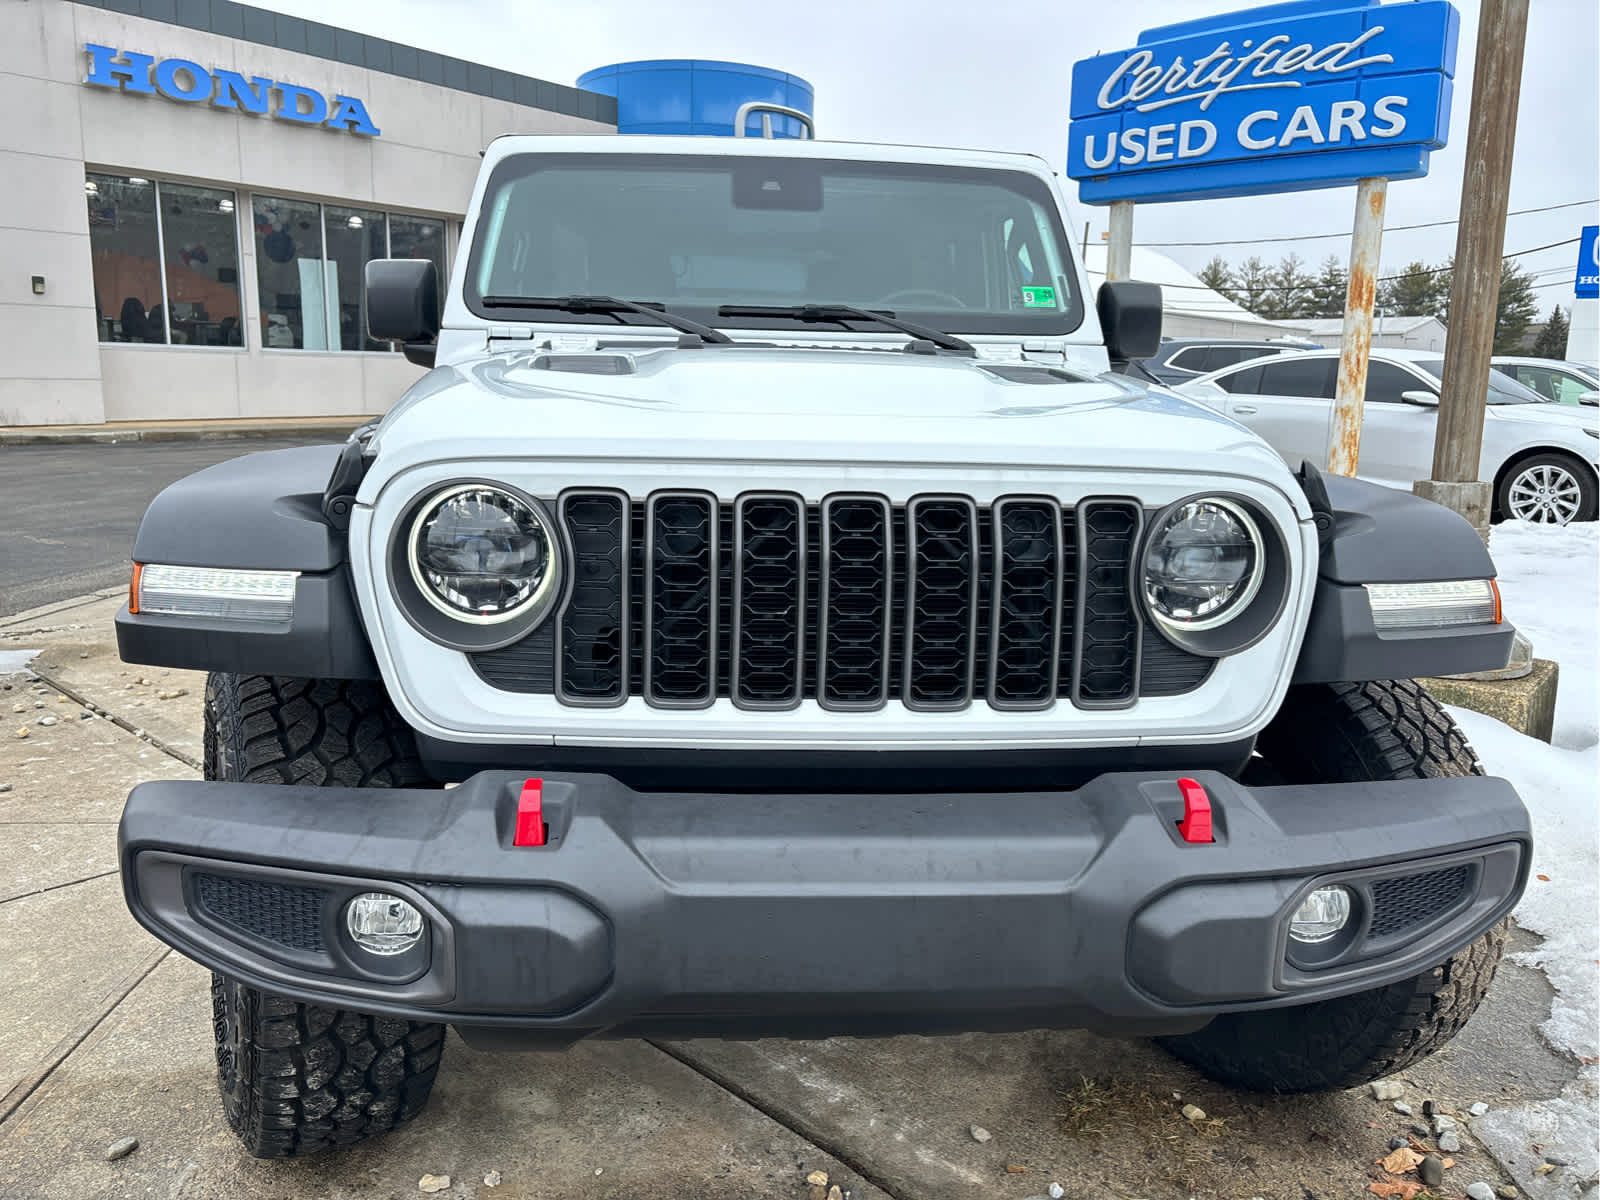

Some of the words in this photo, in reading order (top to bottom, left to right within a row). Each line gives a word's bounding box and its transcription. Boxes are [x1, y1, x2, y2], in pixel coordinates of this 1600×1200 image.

[85, 43, 381, 136] HONDA
[1097, 26, 1394, 112] Certified
[1084, 119, 1217, 169] USED
[1237, 95, 1408, 150] CARS
